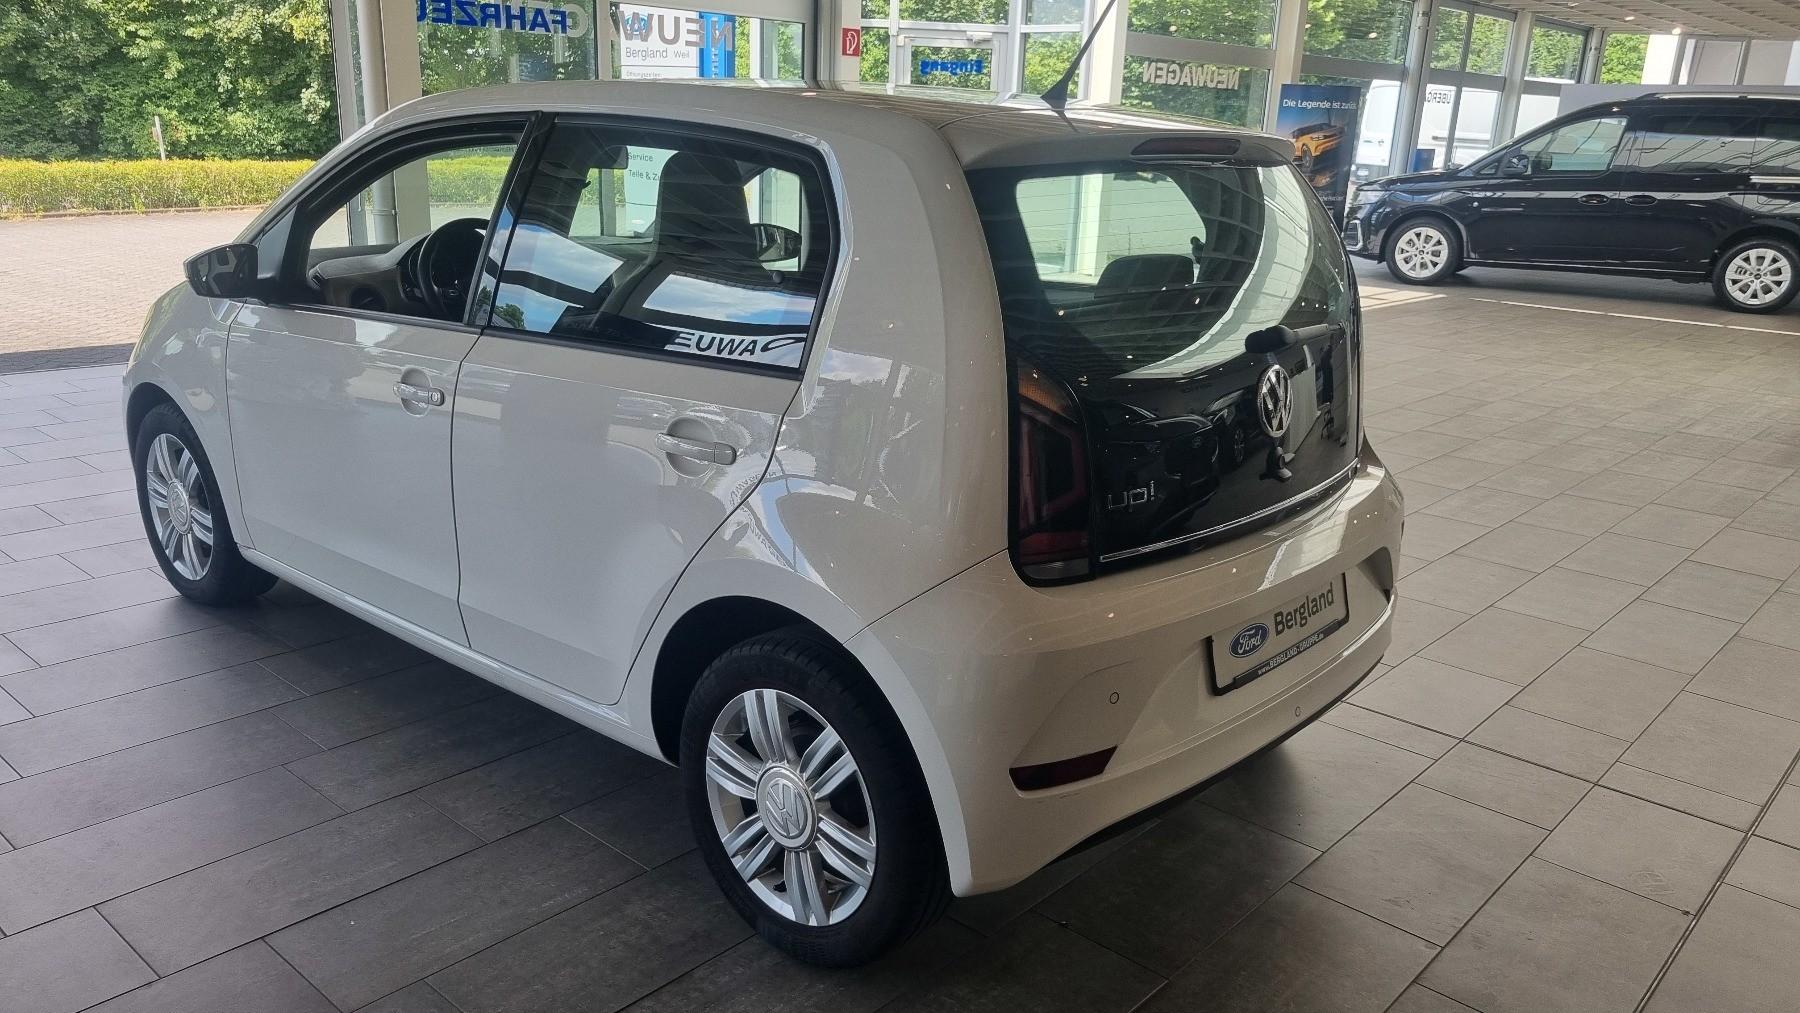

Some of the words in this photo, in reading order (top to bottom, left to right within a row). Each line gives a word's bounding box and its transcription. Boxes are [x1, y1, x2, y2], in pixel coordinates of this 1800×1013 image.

[625, 47, 668, 61] Bergland
[1283, 99, 1296, 107] Die
[1298, 100, 1331, 109] Legende
[1332, 100, 1340, 109] ist
[628, 152, 653, 161] Service
[1274, 582, 1334, 636] Bergland
[1235, 627, 1264, 656] Ford
